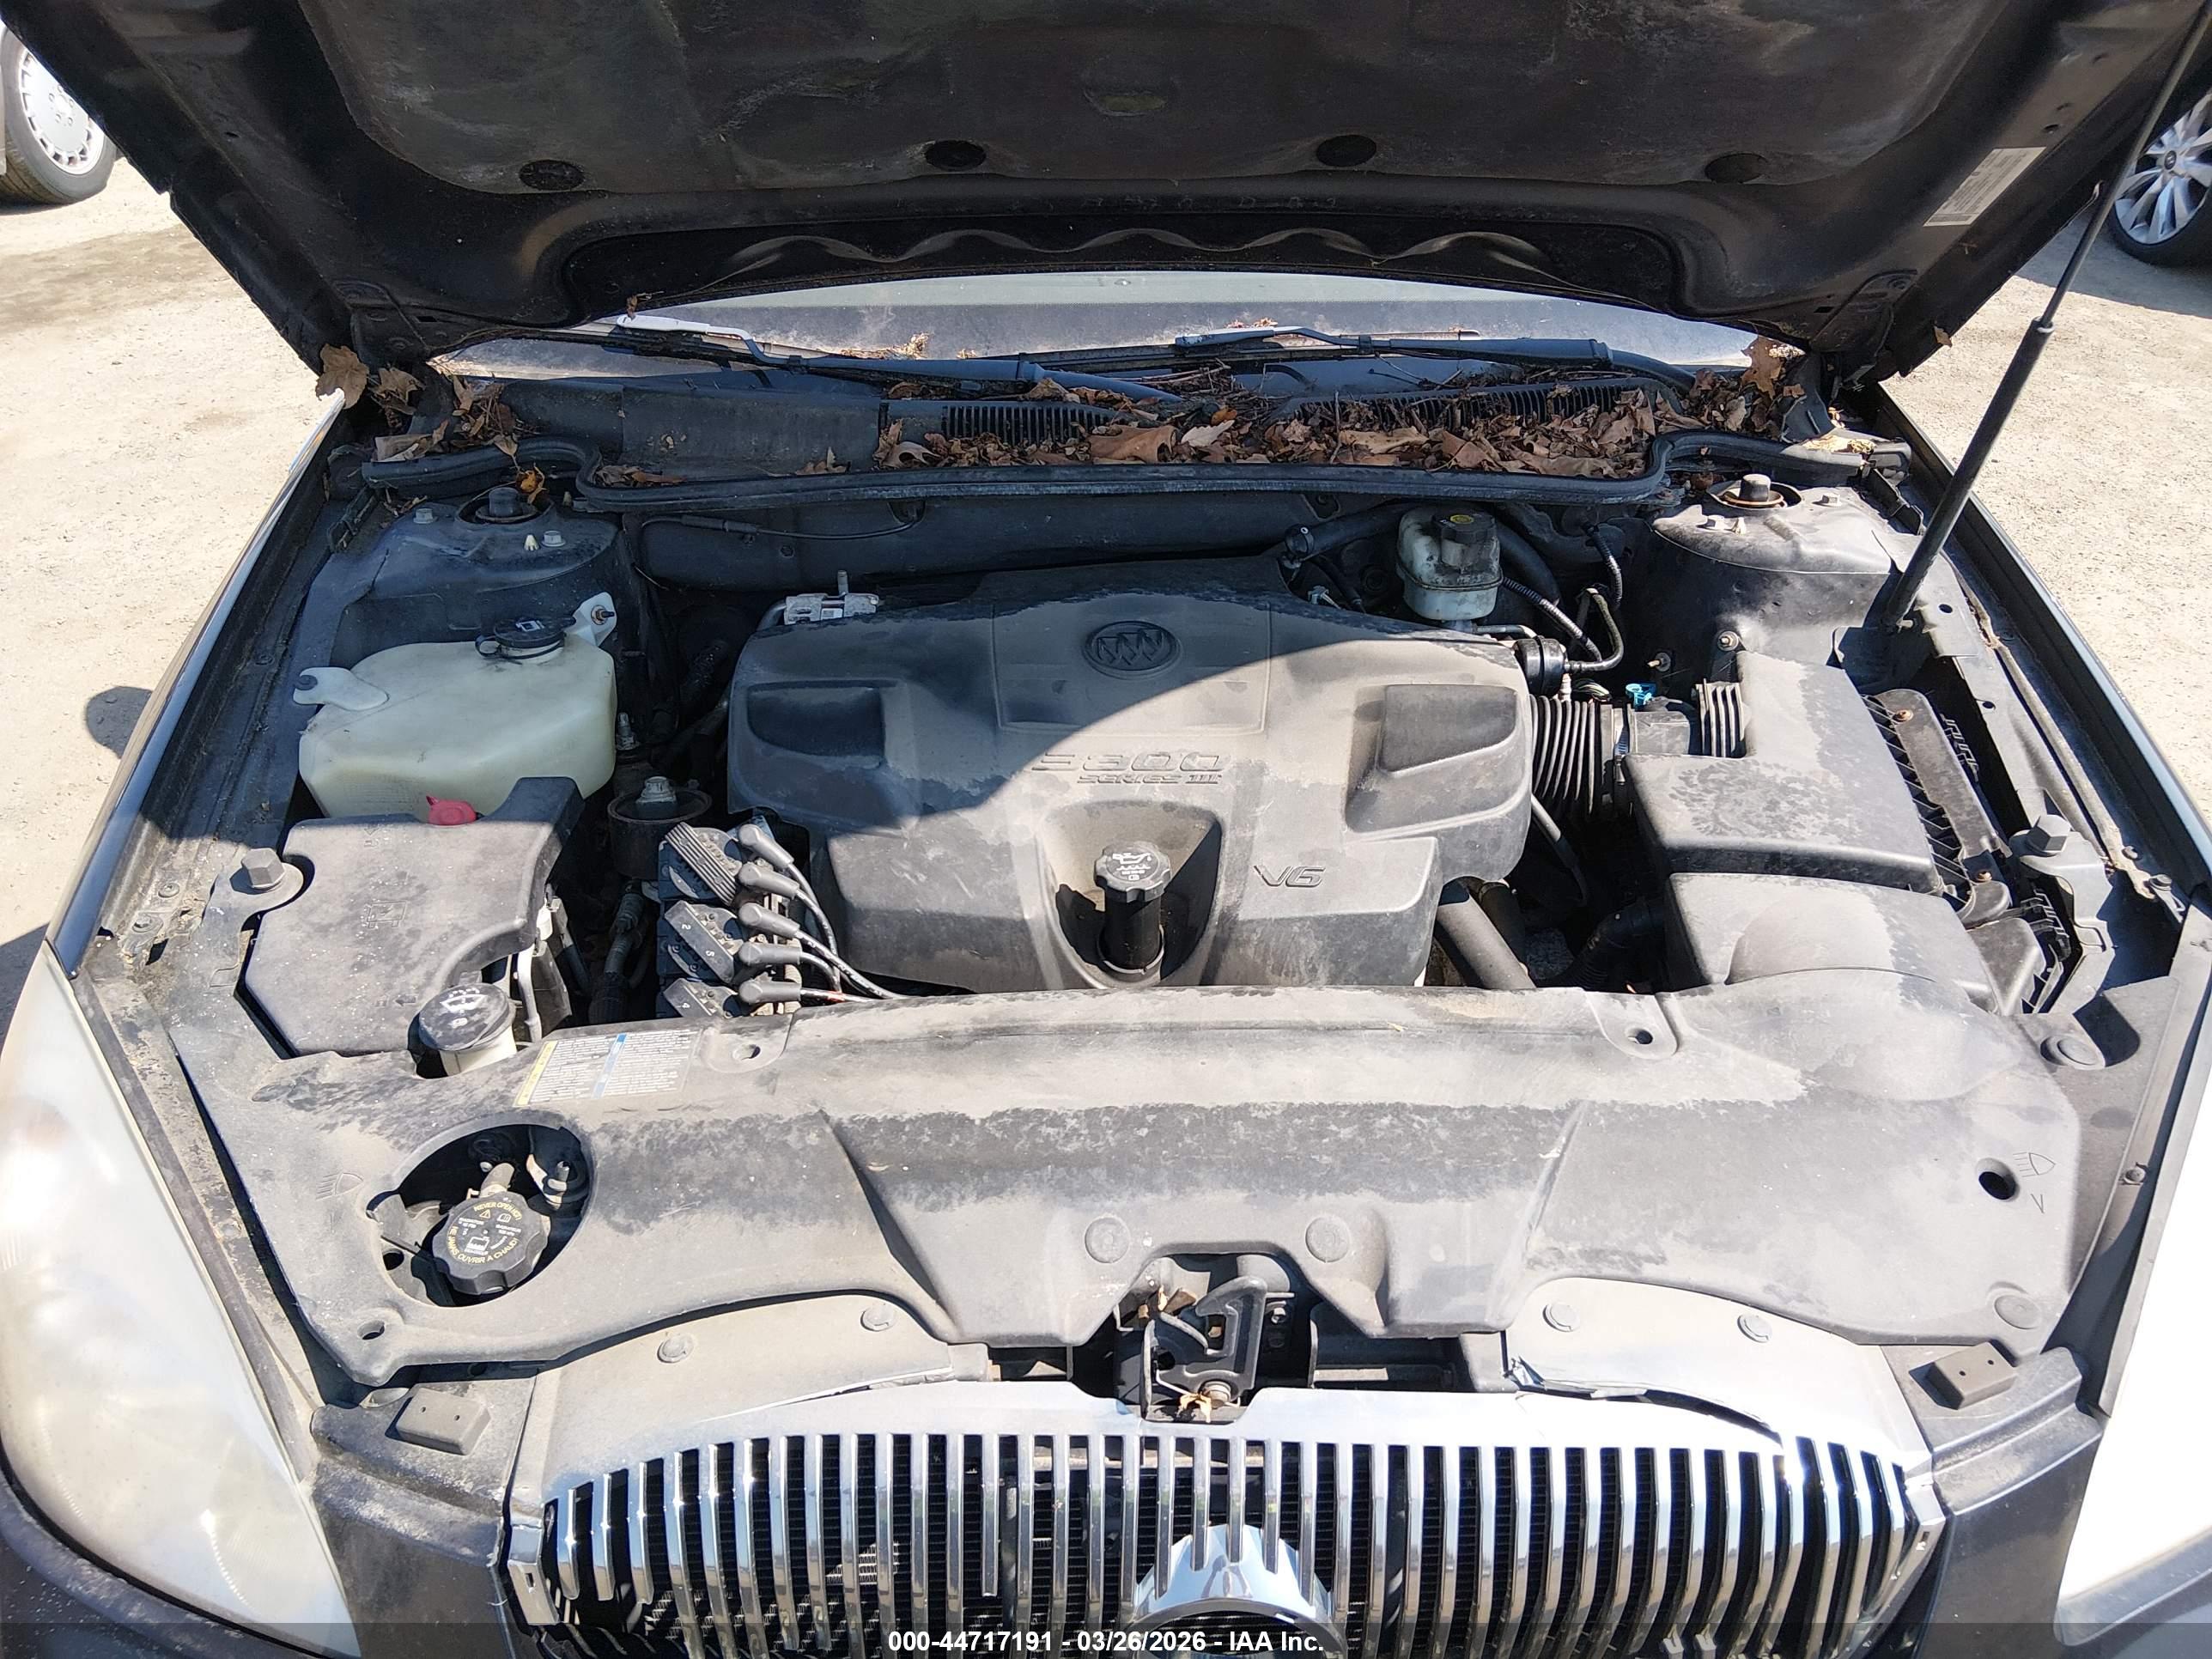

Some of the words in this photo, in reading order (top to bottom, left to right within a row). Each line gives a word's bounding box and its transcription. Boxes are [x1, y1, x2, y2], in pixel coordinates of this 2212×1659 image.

[1077, 775, 1182, 784] SERIES
[1254, 865, 1326, 888] V6
[473, 1201, 496, 1212] NEVER
[496, 1201, 515, 1212] OPEN
[458, 1253, 486, 1264] OUVRIR
[493, 1237, 520, 1260] CHAUD!
